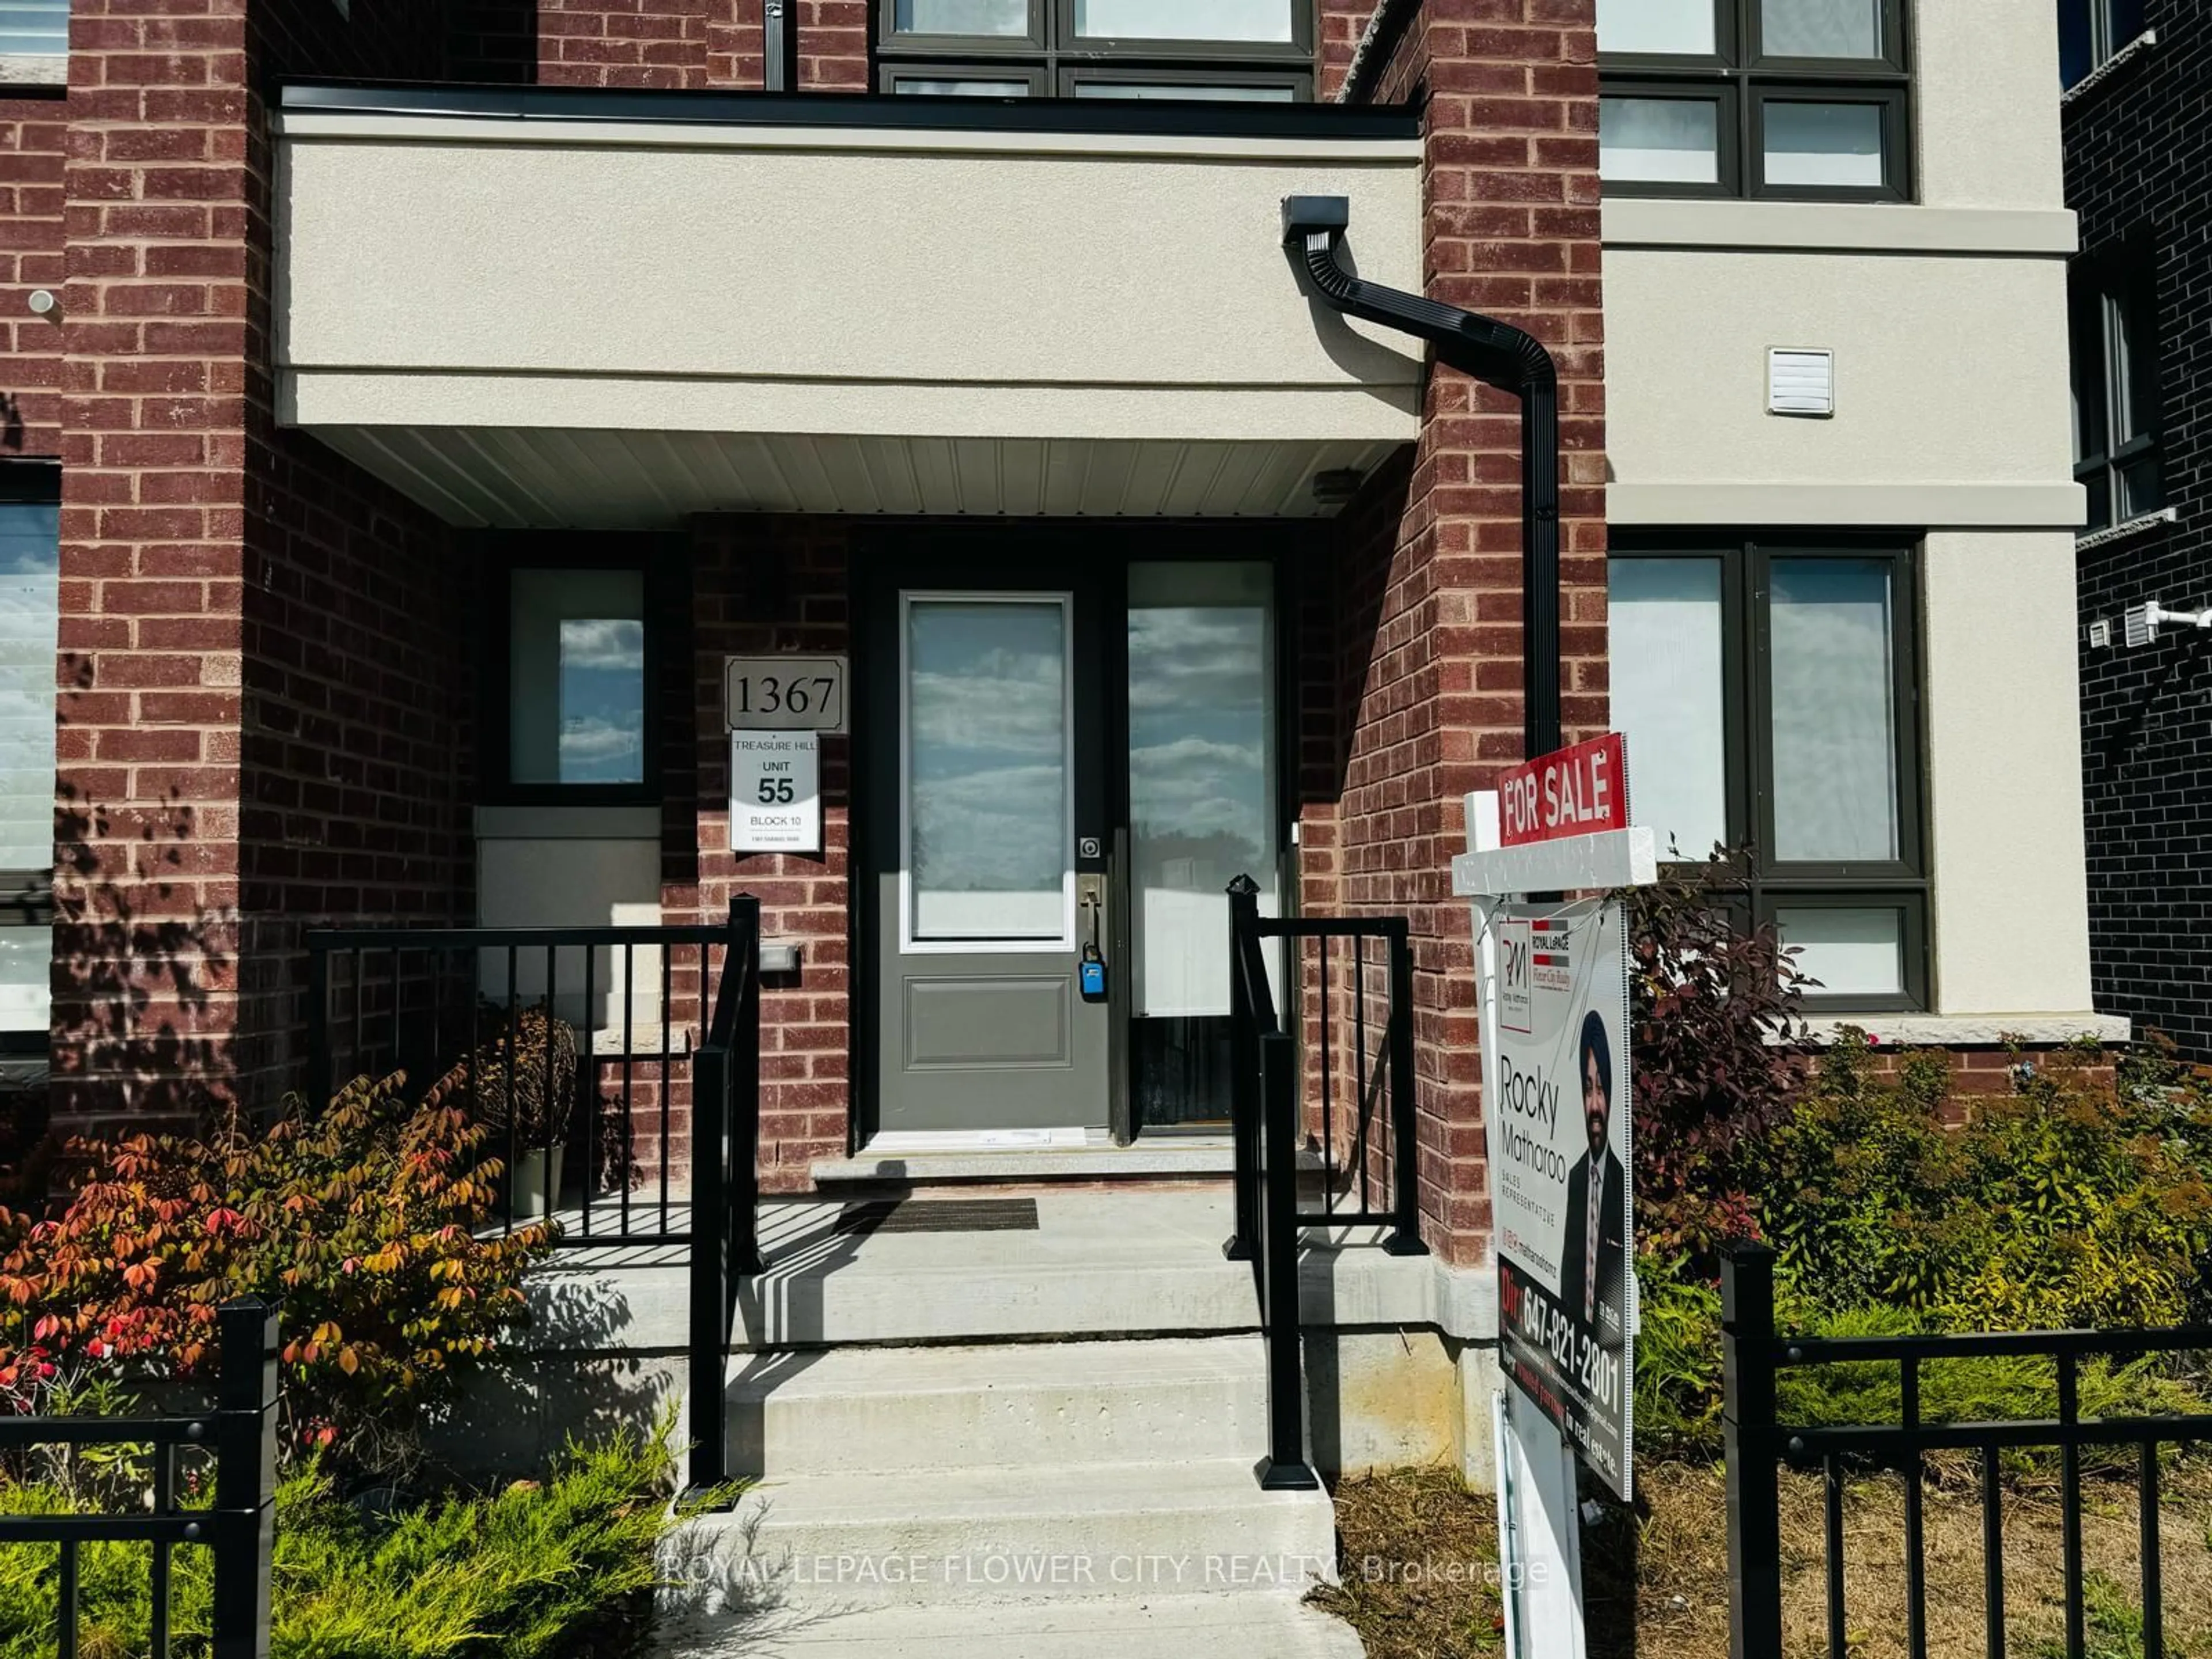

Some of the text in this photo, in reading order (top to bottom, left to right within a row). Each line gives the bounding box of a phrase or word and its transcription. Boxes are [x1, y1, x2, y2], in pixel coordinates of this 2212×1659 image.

[738, 677, 834, 713] 1367
[735, 741, 792, 751] TREASURE
[763, 762, 791, 771] UNIT
[757, 778, 794, 804] 55
[1505, 749, 1609, 836] FOR SALE
[751, 817, 801, 825] BLOCK 10
[1500, 1055, 1559, 1140] Rocky
[1502, 1120, 1566, 1184] Matharoo
[1524, 1286, 1619, 1414] 647-821-2801
[1574, 1419, 1590, 1450] real
